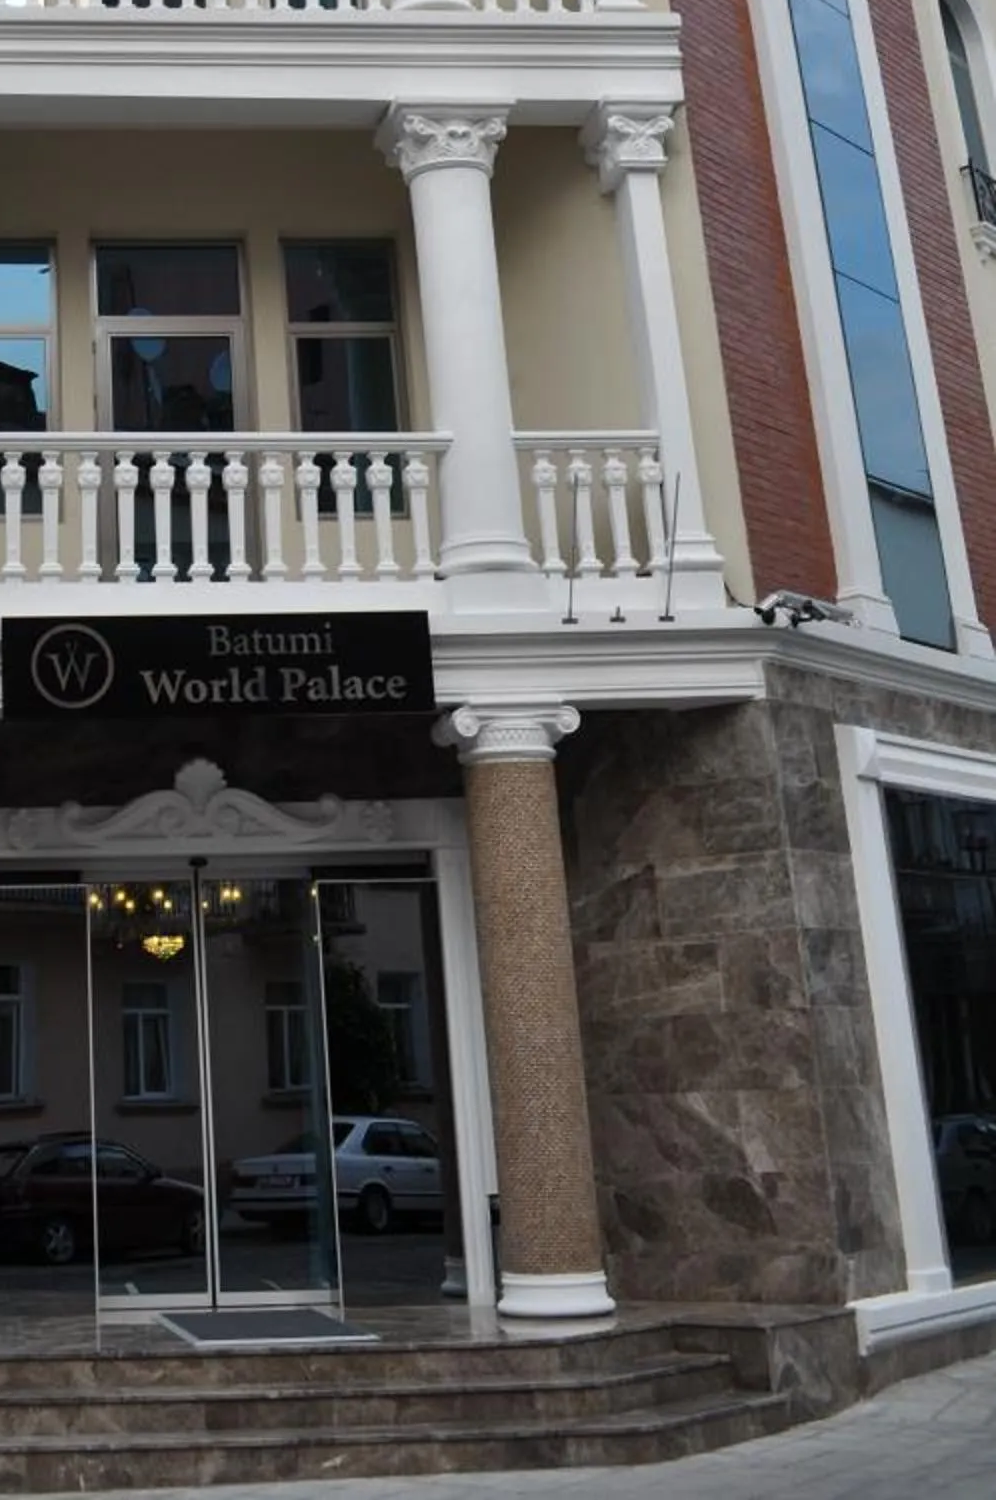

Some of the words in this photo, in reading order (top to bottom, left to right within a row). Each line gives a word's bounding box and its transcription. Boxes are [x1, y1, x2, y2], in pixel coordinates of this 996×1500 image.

[208, 622, 334, 656] Batumi
[48, 642, 99, 691] W
[140, 669, 269, 704] World
[281, 664, 406, 701] Palace
